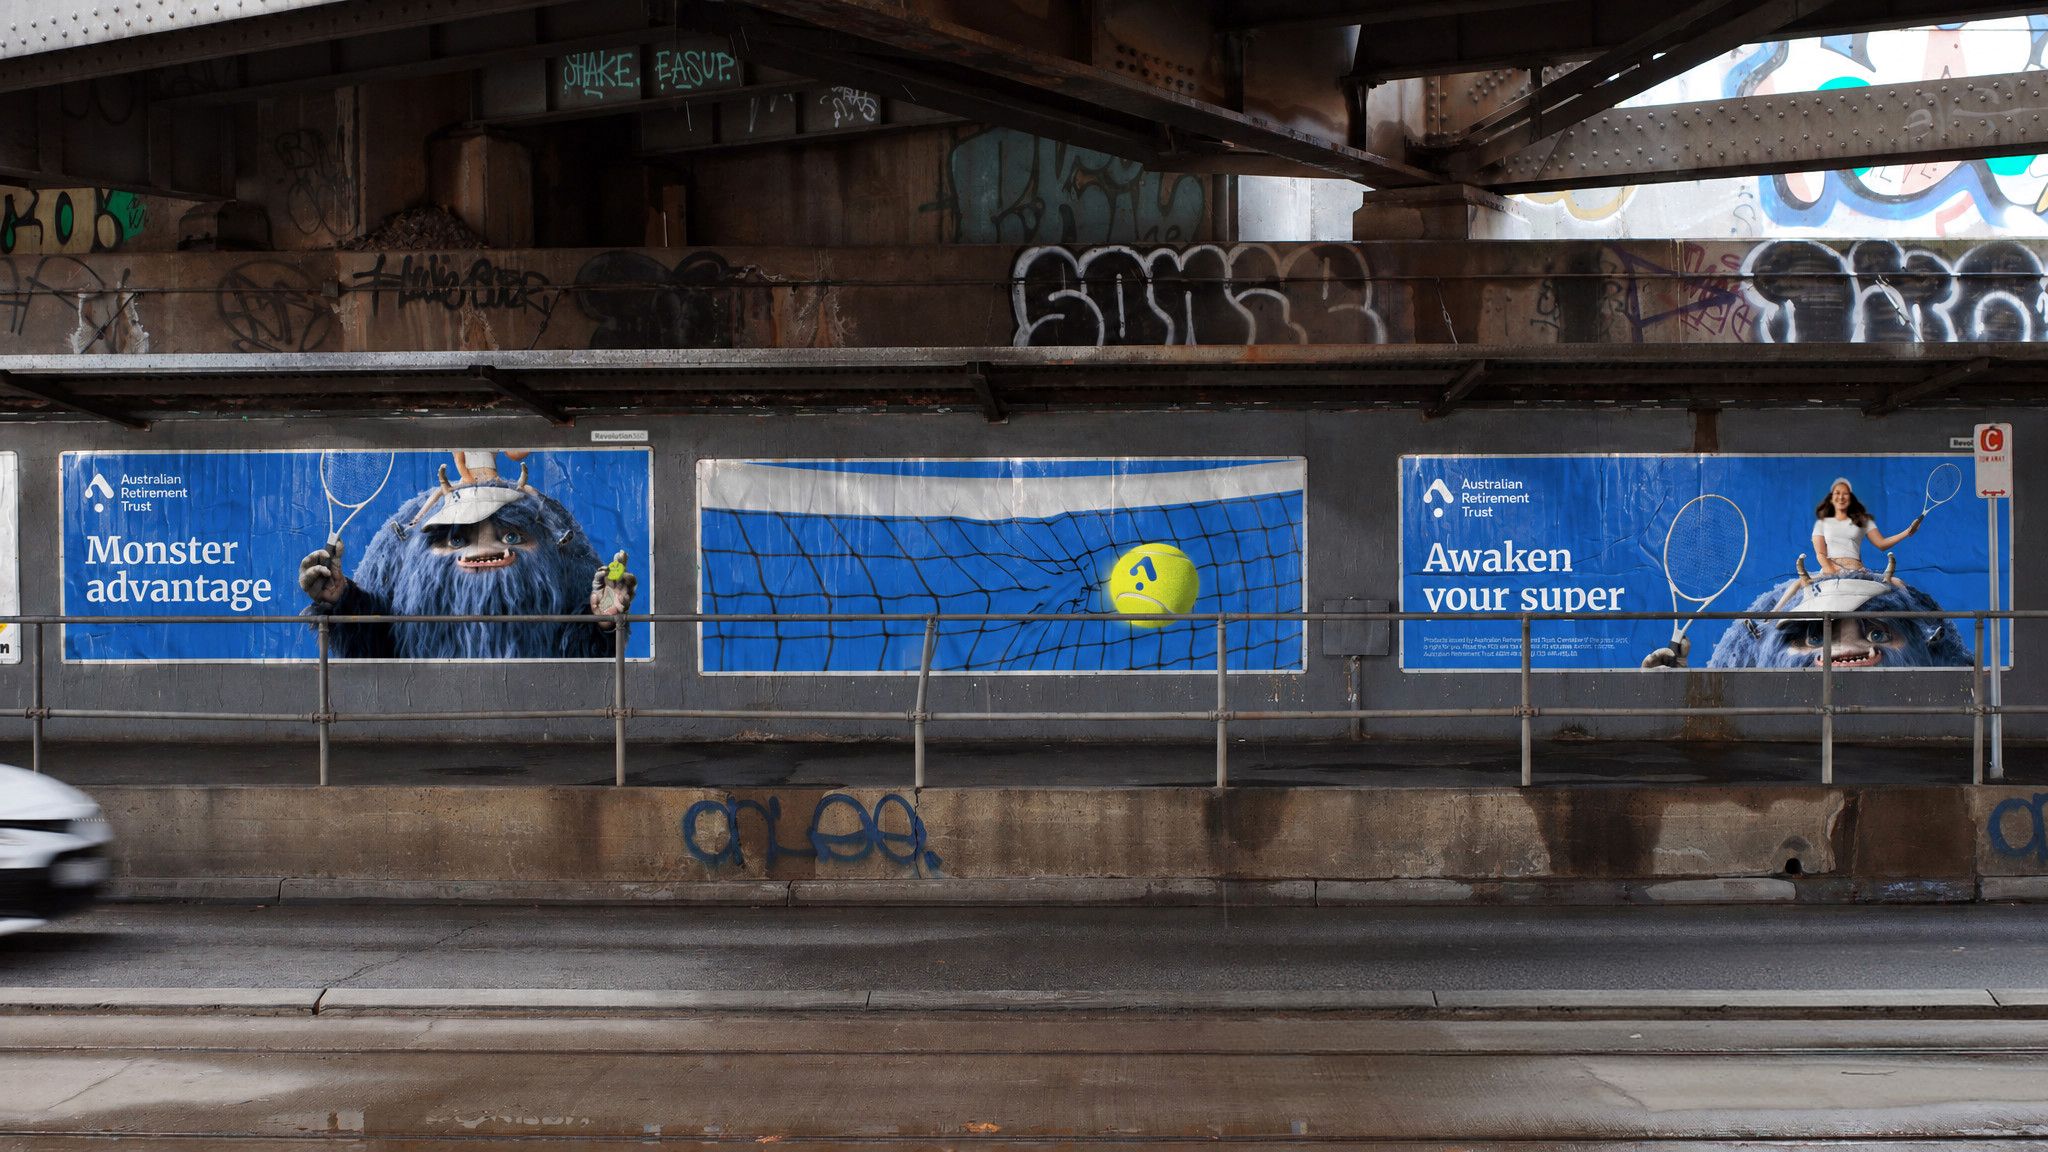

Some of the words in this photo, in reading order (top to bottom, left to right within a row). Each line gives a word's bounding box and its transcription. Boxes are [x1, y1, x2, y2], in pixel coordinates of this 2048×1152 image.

[1986, 430, 1998, 450] C
[121, 473, 182, 485] Australian
[1461, 478, 1523, 490] Australian
[121, 487, 188, 498] Retirement
[1461, 492, 1530, 503] Retirement
[121, 500, 152, 512] Trust
[1461, 506, 1493, 517] Trust
[85, 535, 239, 565] Monster
[1422, 540, 1573, 572] Awaken
[86, 570, 272, 612] advantage
[1423, 587, 1510, 621] your
[1520, 587, 1625, 621] super
